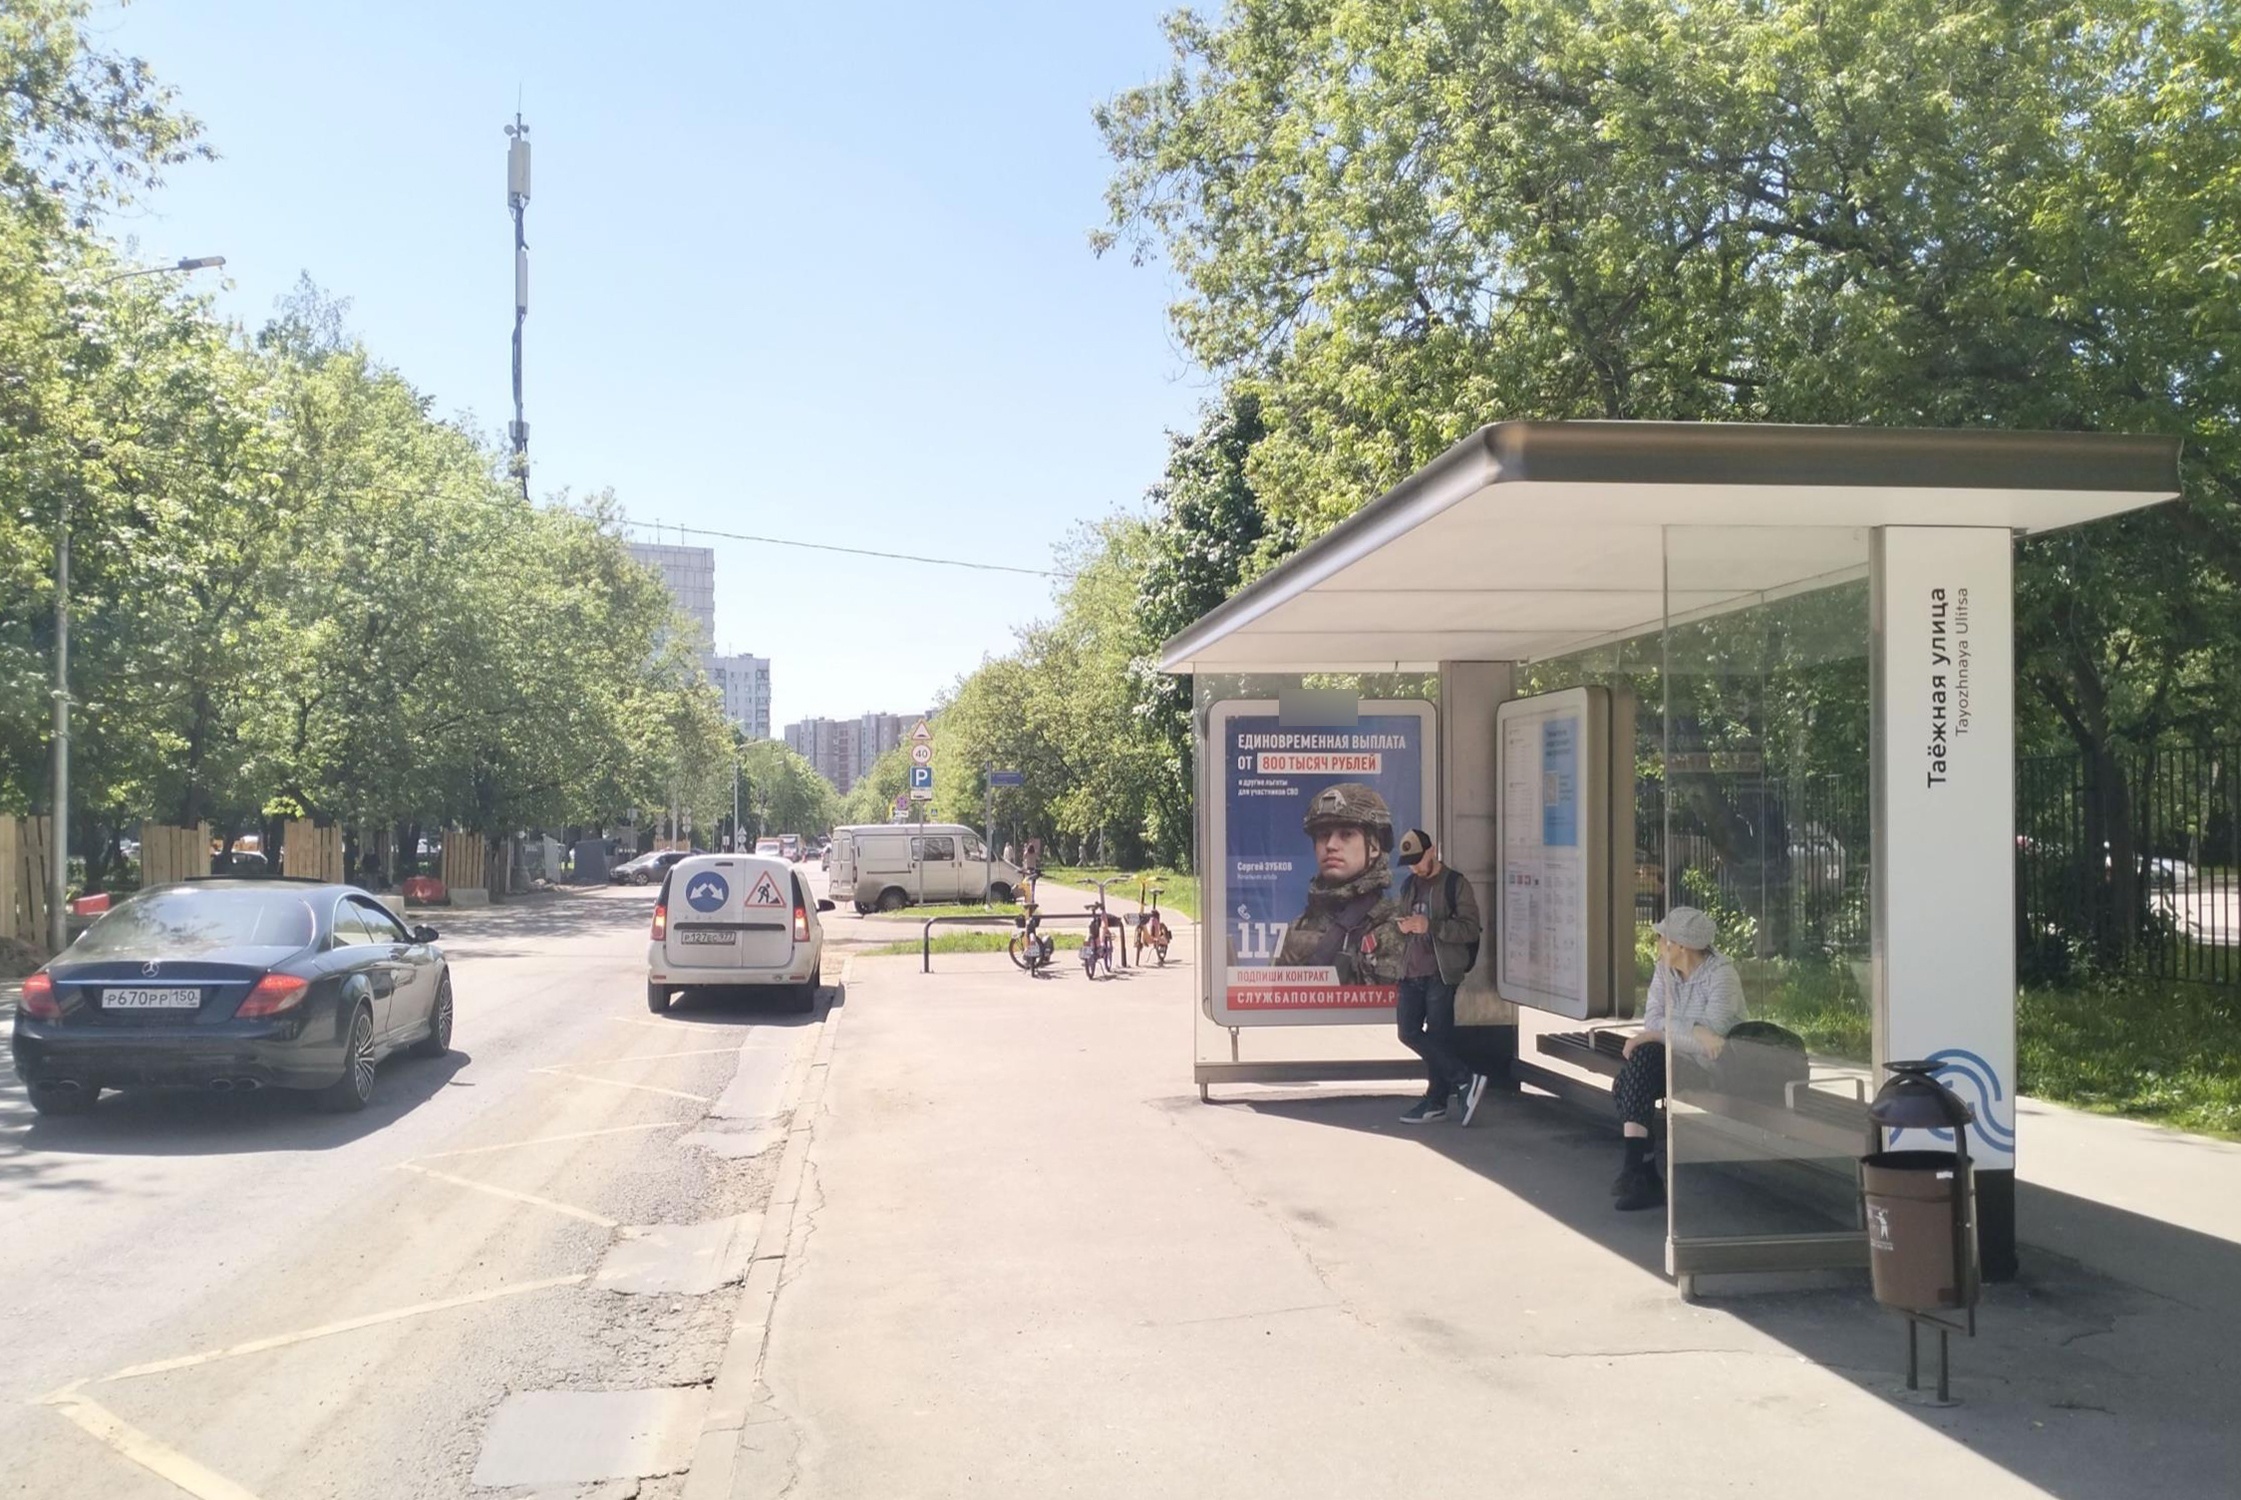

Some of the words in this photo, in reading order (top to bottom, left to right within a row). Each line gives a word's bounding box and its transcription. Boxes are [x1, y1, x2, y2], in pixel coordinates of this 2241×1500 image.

[1955, 588, 1968, 634] Ulitsa
[1931, 588, 1950, 666] улица
[1955, 640, 1971, 737] Tayozhnaya
[1238, 734, 1349, 750] ЕДИНОВРЕМЕННАЯ
[1352, 735, 1406, 749] ВЫПЛАТА
[1927, 675, 1947, 788] Таёжная
[916, 750, 928, 758] 40
[1238, 756, 1252, 770] ОТ
[1262, 756, 1286, 770] 800
[1289, 756, 1328, 770] ТЫСЯЧ
[1332, 754, 1376, 770] РУБЛЕЙ
[1237, 922, 1289, 958] 117
[1237, 970, 1283, 983] ПОДПИШИ
[1286, 970, 1329, 982] КОНТРАКТ
[108, 991, 168, 1006] Р670РР
[171, 990, 195, 1002] 150
